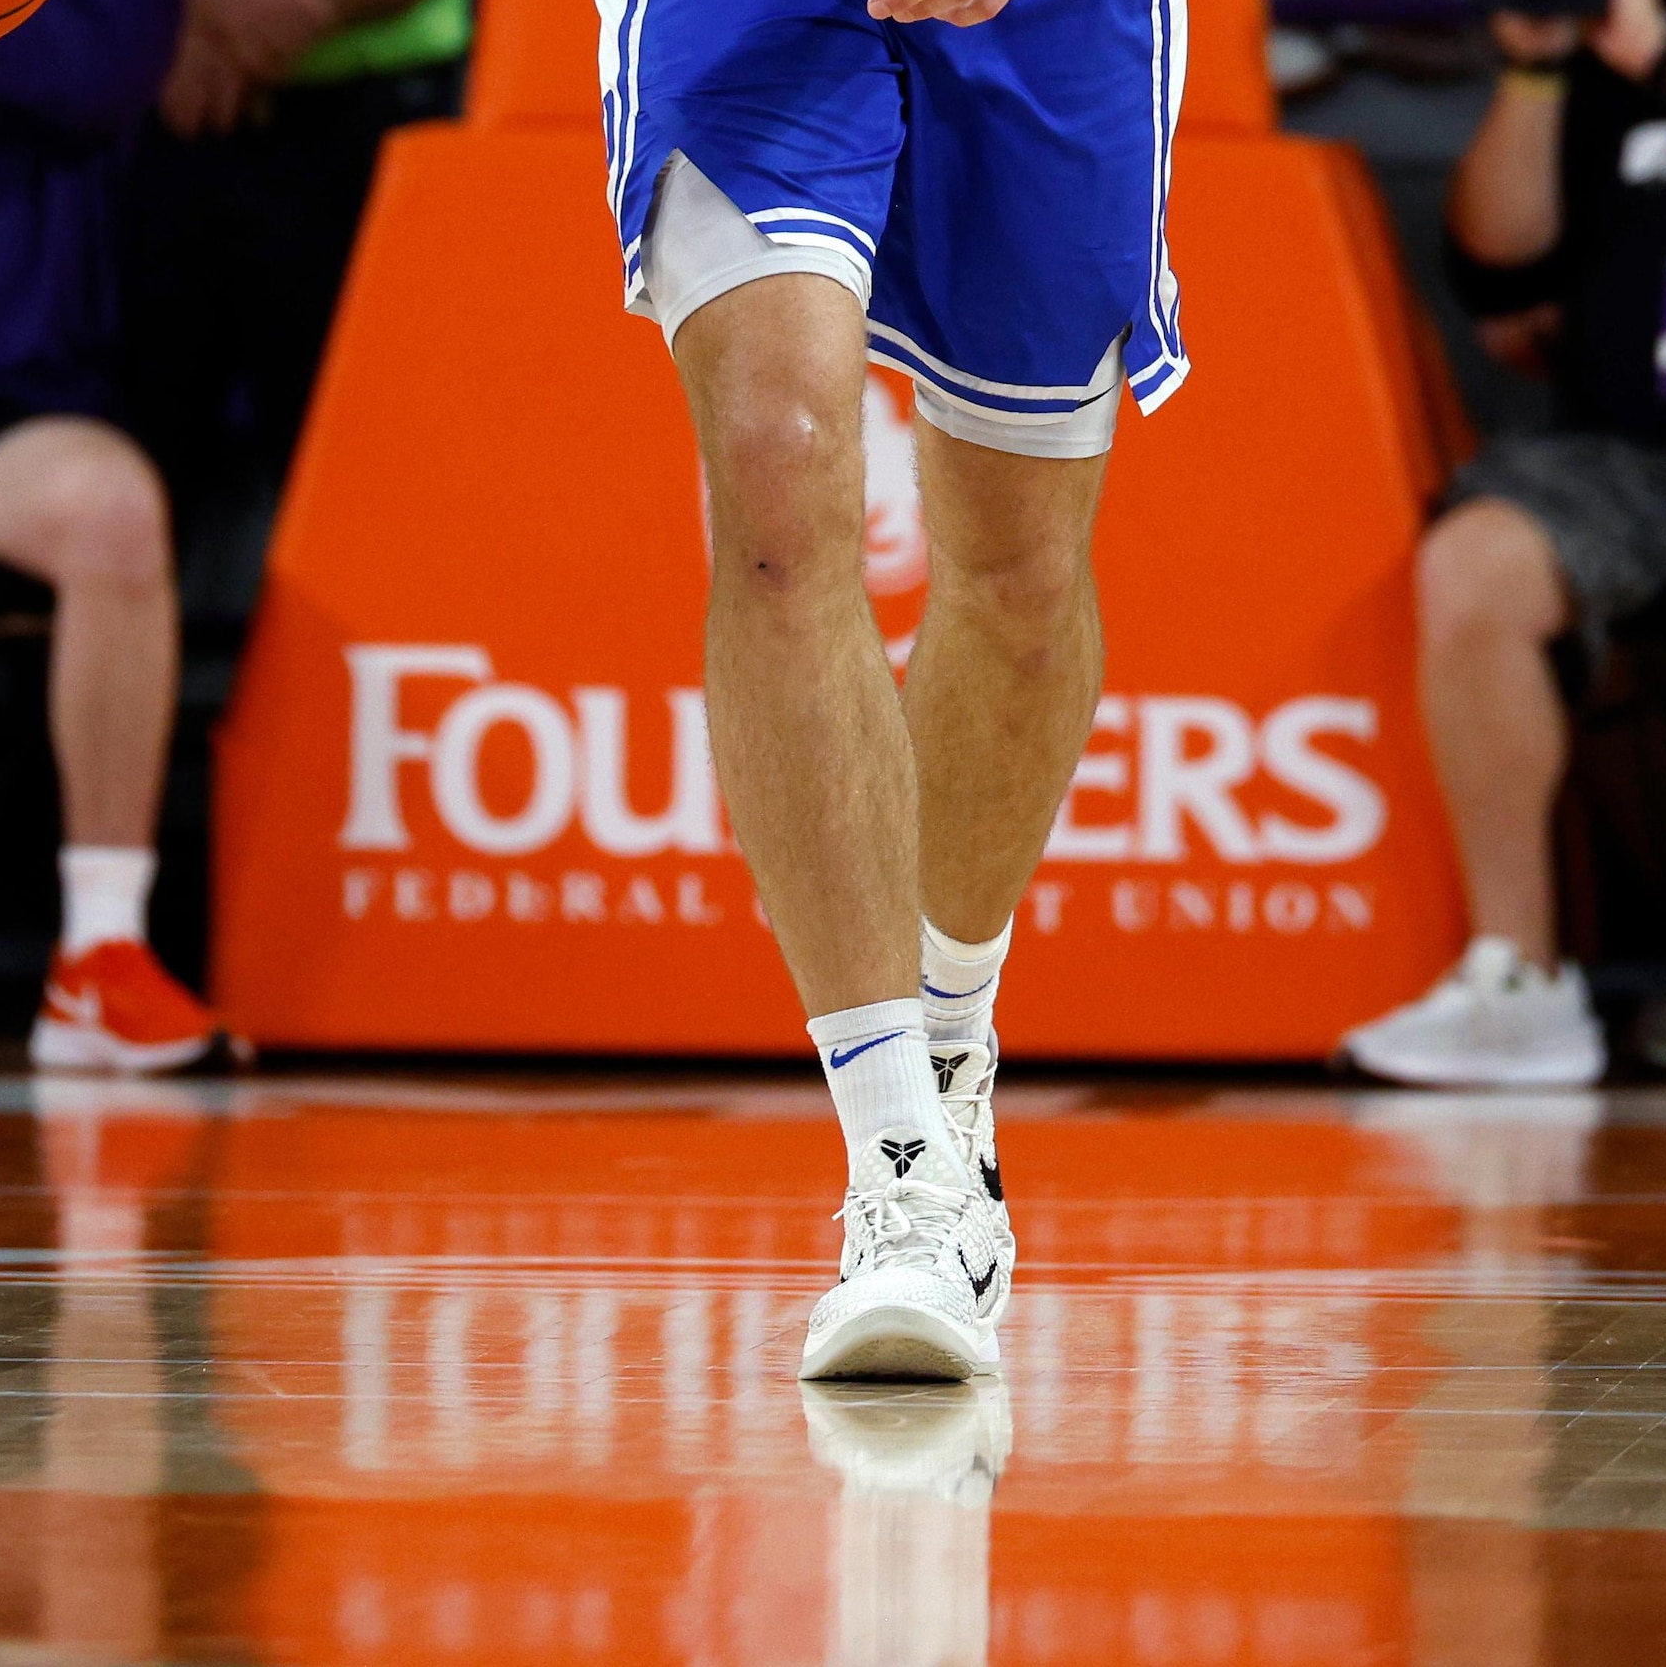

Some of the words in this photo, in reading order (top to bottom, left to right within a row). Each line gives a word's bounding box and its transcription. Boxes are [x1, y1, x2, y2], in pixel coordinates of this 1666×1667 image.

[341, 644, 1386, 864] FOUERS
[341, 869, 724, 925] FEDERAL
[1111, 880, 1376, 933] UNION
